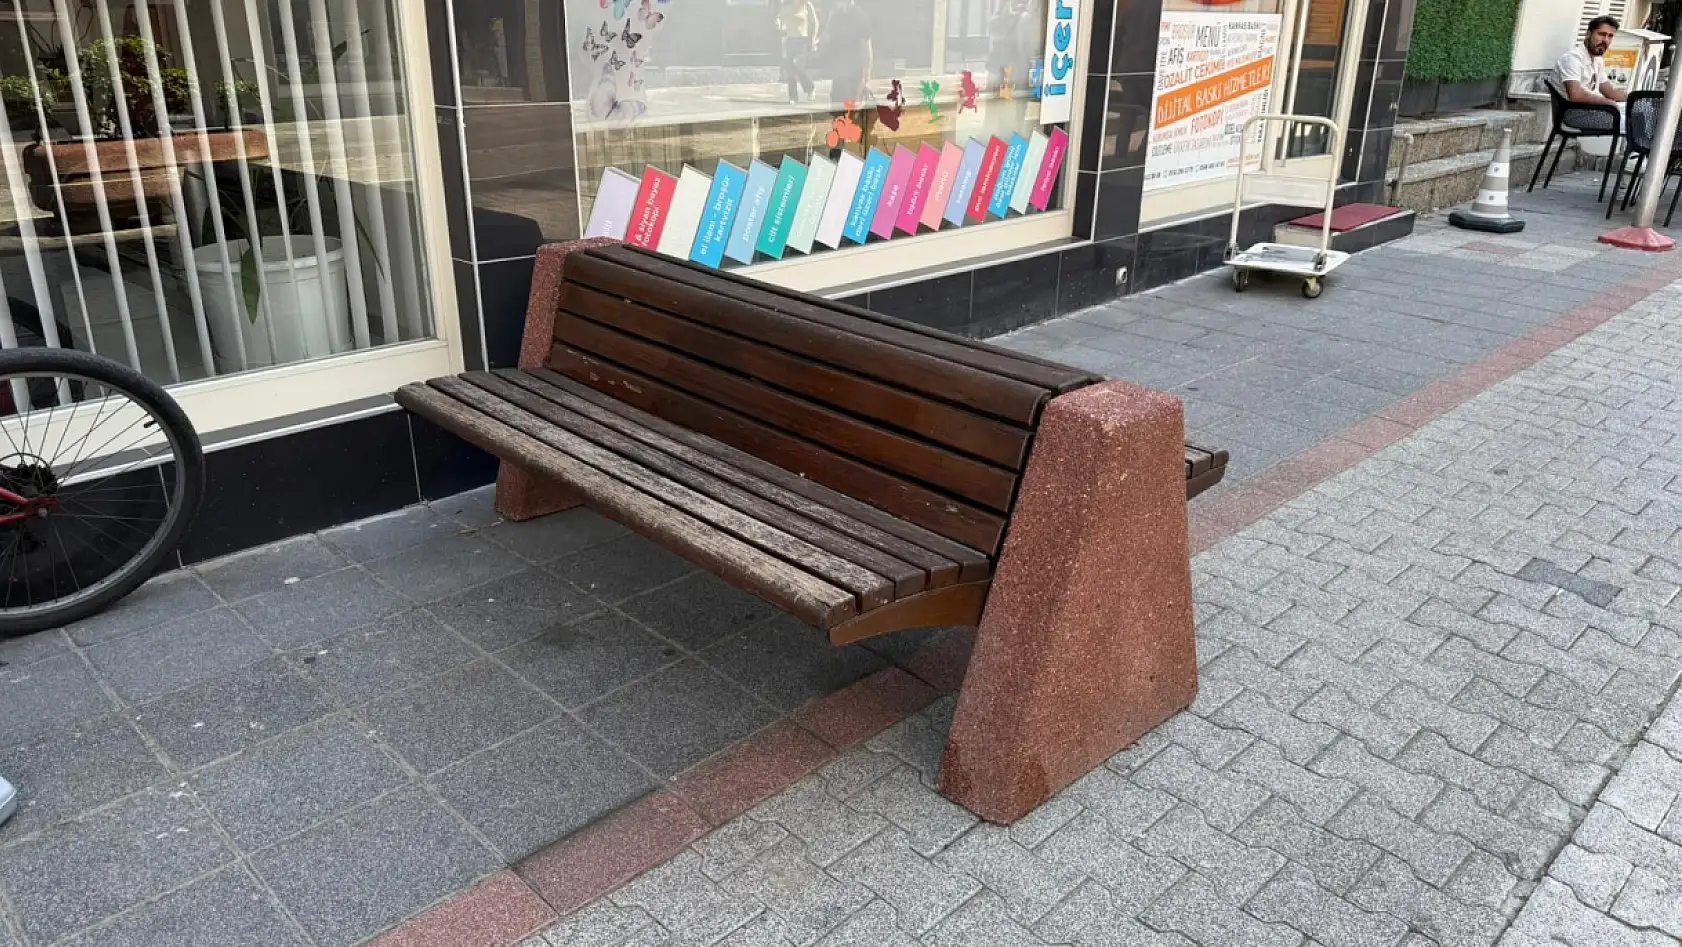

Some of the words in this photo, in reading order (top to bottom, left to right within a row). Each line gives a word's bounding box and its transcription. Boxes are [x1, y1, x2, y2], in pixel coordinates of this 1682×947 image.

[1195, 21, 1221, 47] MENÜ
[1157, 92, 1193, 125] DİJİTAL
[1195, 80, 1223, 109] BASKI
[647, 176, 661, 206] beyaz
[714, 198, 734, 242] kartvizit
